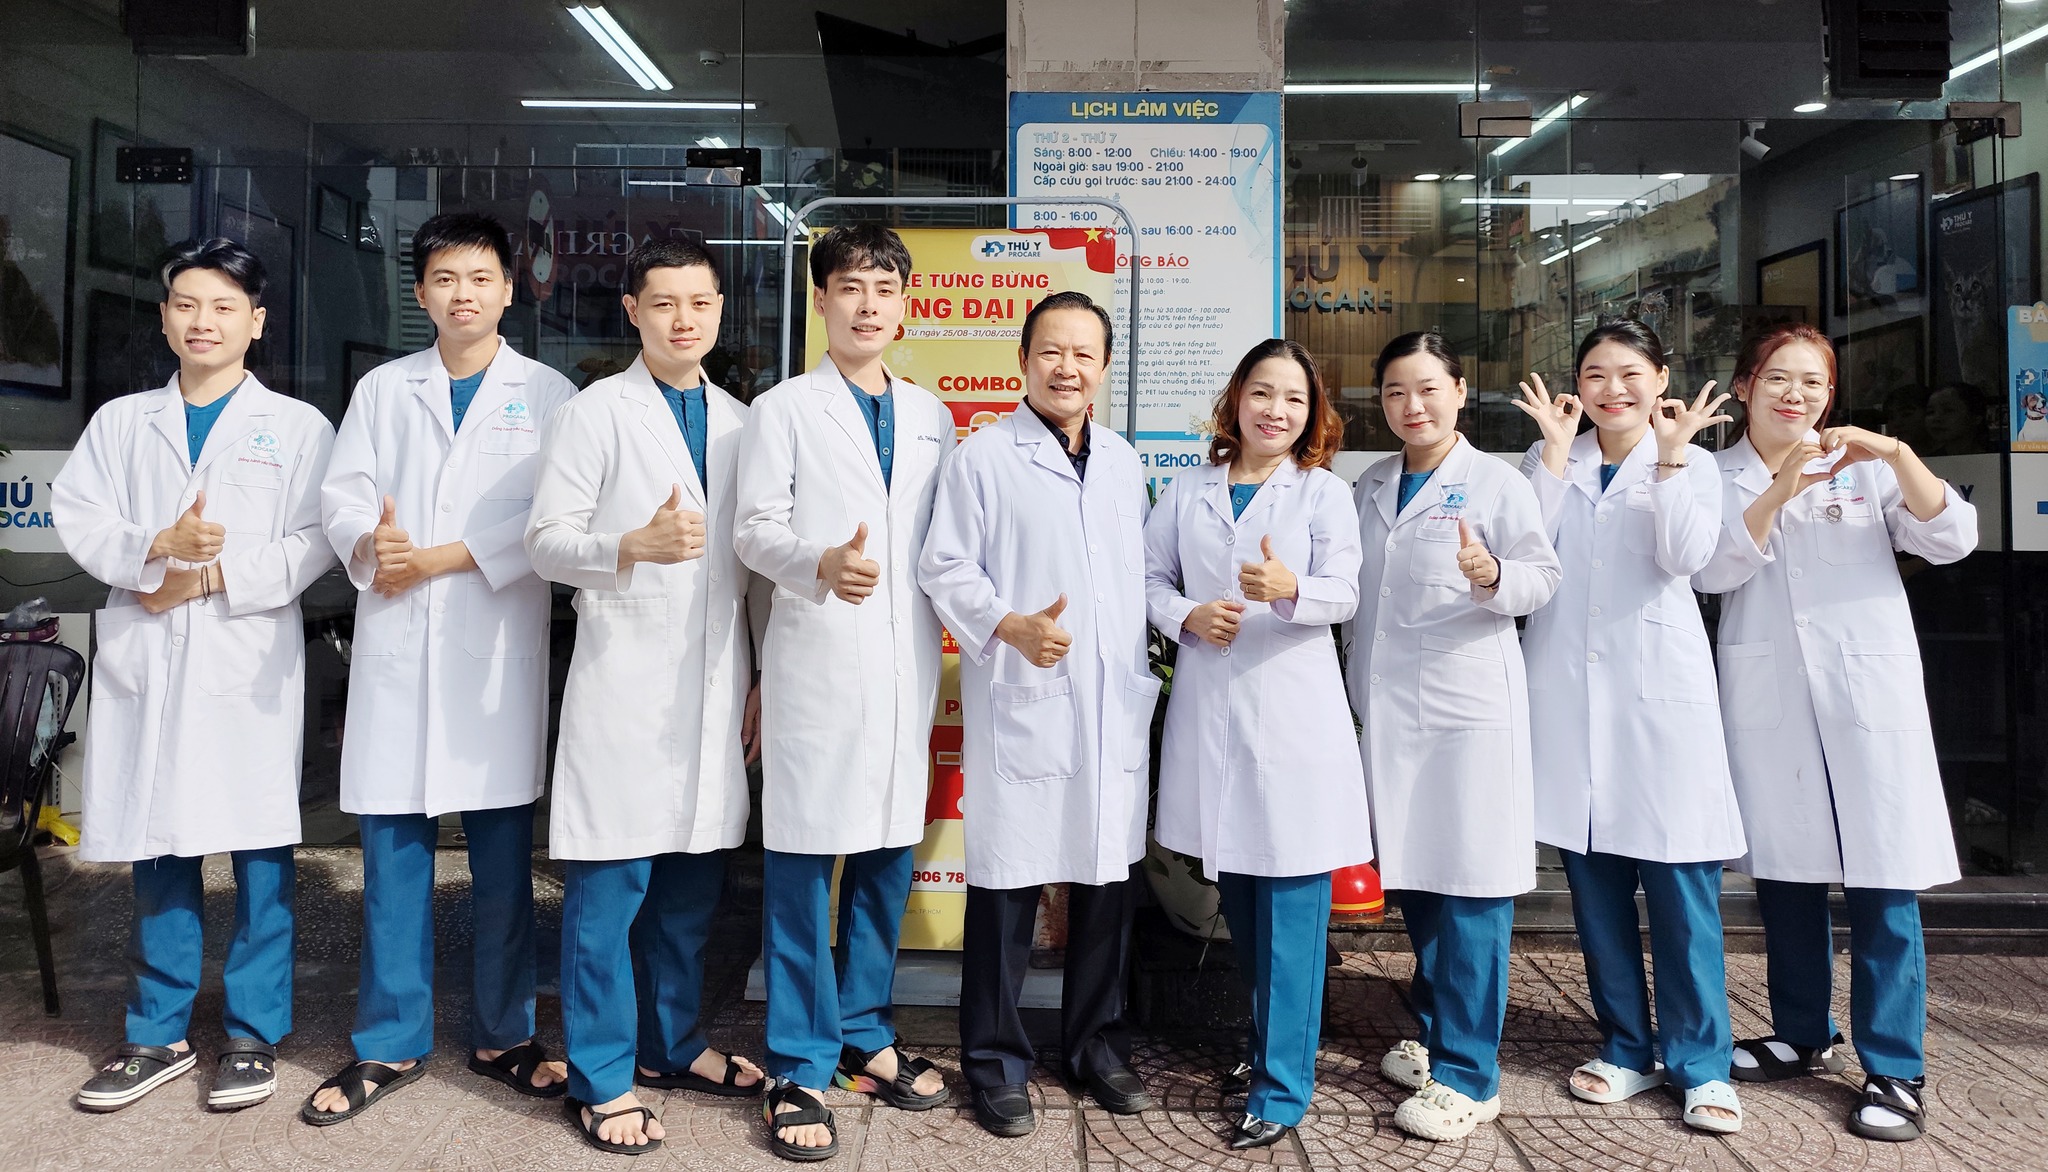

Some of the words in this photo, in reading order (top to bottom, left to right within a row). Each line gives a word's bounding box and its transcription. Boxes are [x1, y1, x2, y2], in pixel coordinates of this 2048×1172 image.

[1071, 102, 1117, 120] LỊCH
[1123, 99, 1167, 117] LÀM
[1172, 99, 1219, 120] VIỆC
[1033, 131, 1059, 144] THỨ
[1062, 132, 1070, 144] 2
[1081, 131, 1107, 144] THỨ
[1109, 132, 1118, 144] 7
[1033, 147, 1065, 160] Sáng:
[1068, 147, 1092, 158] 8:00
[1104, 147, 1132, 158] 12:00
[1189, 147, 1218, 158] 14:00
[1229, 147, 1258, 158] 19:00
[1033, 161, 1066, 174] Ngoài
[1069, 161, 1089, 174] giờ:
[1091, 163, 1112, 172] sau
[1116, 161, 1144, 172] 19:00
[1155, 161, 1184, 172] 21:00
[1033, 175, 1056, 188] Cấp
[1060, 175, 1082, 186] cứu
[1085, 175, 1102, 188] gọi
[1105, 175, 1138, 186] trước:
[1141, 177, 1162, 186] sau
[1165, 175, 1193, 186] 21:00
[1204, 175, 1237, 186] 24:00
[1033, 211, 1058, 221] 8:00
[1069, 210, 1098, 221] 16:00
[1141, 227, 1162, 236] sau
[1165, 225, 1193, 236] 16:00
[1204, 225, 1237, 236] 24:00
[1007, 239, 1030, 251] THÚ
[1033, 241, 1042, 251] Y
[1157, 252, 1190, 267] BÁO
[1356, 244, 1391, 283] Y
[929, 272, 985, 288] TƯNG
[991, 270, 1050, 288] BỪNG
[961, 298, 1014, 324] ĐẠI
[907, 328, 918, 337] Từ
[919, 330, 941, 338] ngày
[942, 328, 1022, 338] 25/08-31/08/2025
[937, 375, 1023, 392] COMBO
[1153, 452, 1202, 468] 12h00
